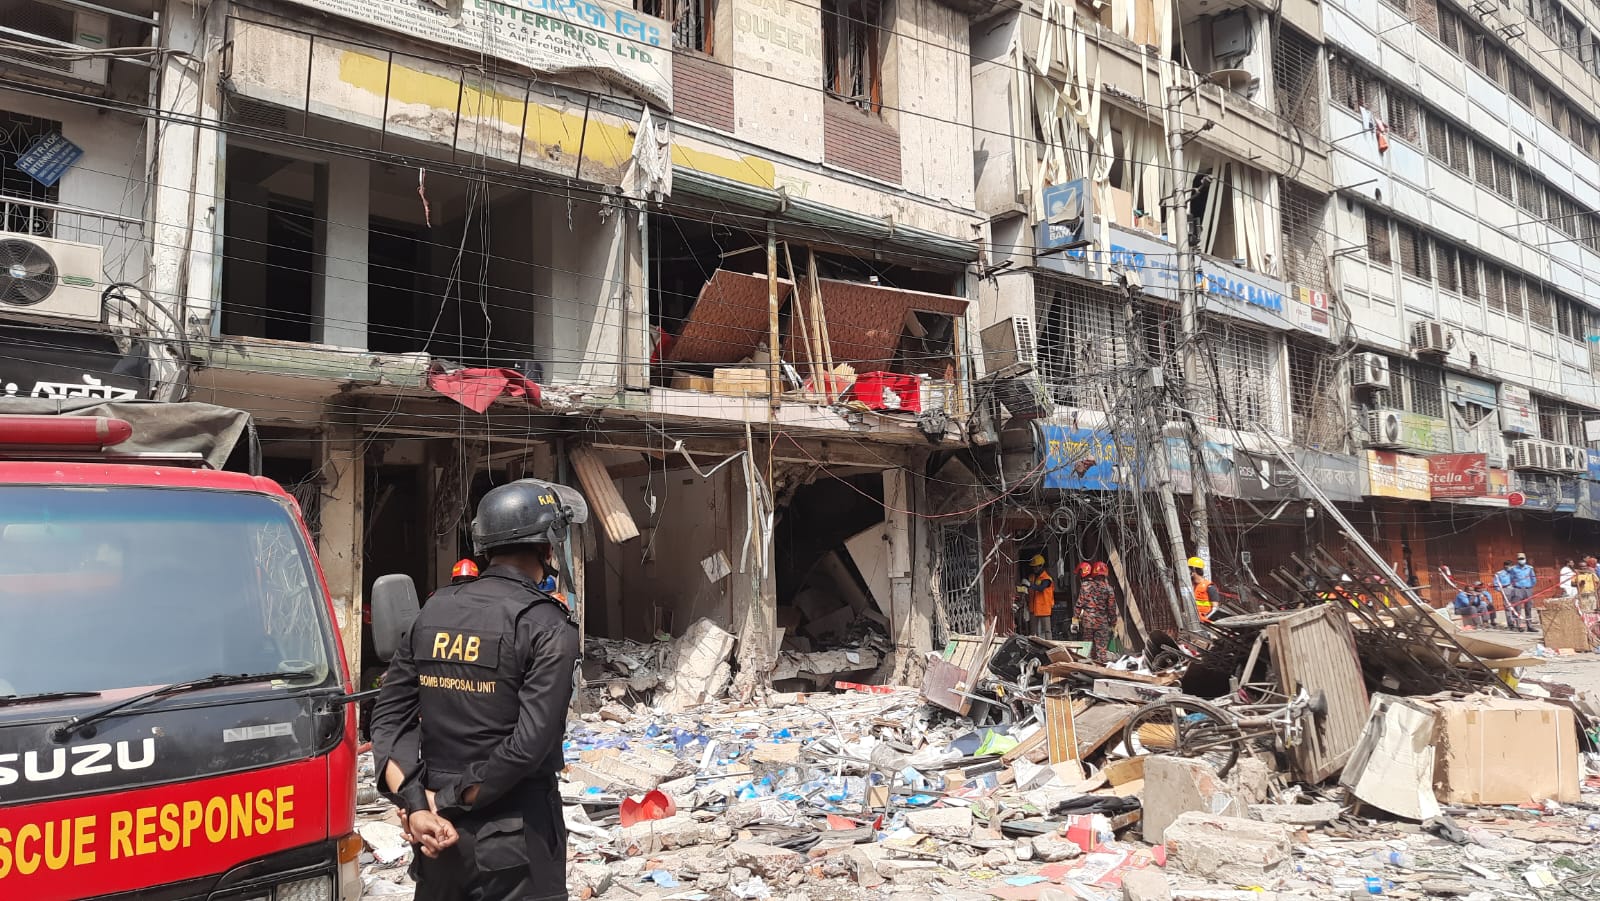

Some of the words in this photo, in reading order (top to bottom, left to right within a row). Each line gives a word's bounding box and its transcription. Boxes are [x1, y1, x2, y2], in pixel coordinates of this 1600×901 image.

[474, 0, 610, 51] ENTERPRISE
[616, 42, 659, 65] LTD.
[529, 38, 572, 57] Freight
[734, 8, 821, 60] QUEEN
[1208, 274, 1245, 301] BRAC
[1247, 285, 1283, 312] BANK
[1428, 472, 1462, 483] Stella
[432, 632, 481, 662] RAB
[419, 674, 438, 688] BOMB
[440, 676, 476, 692] DISPOSAL
[477, 681, 497, 693] UNIT
[110, 785, 295, 860] RESPONSE
